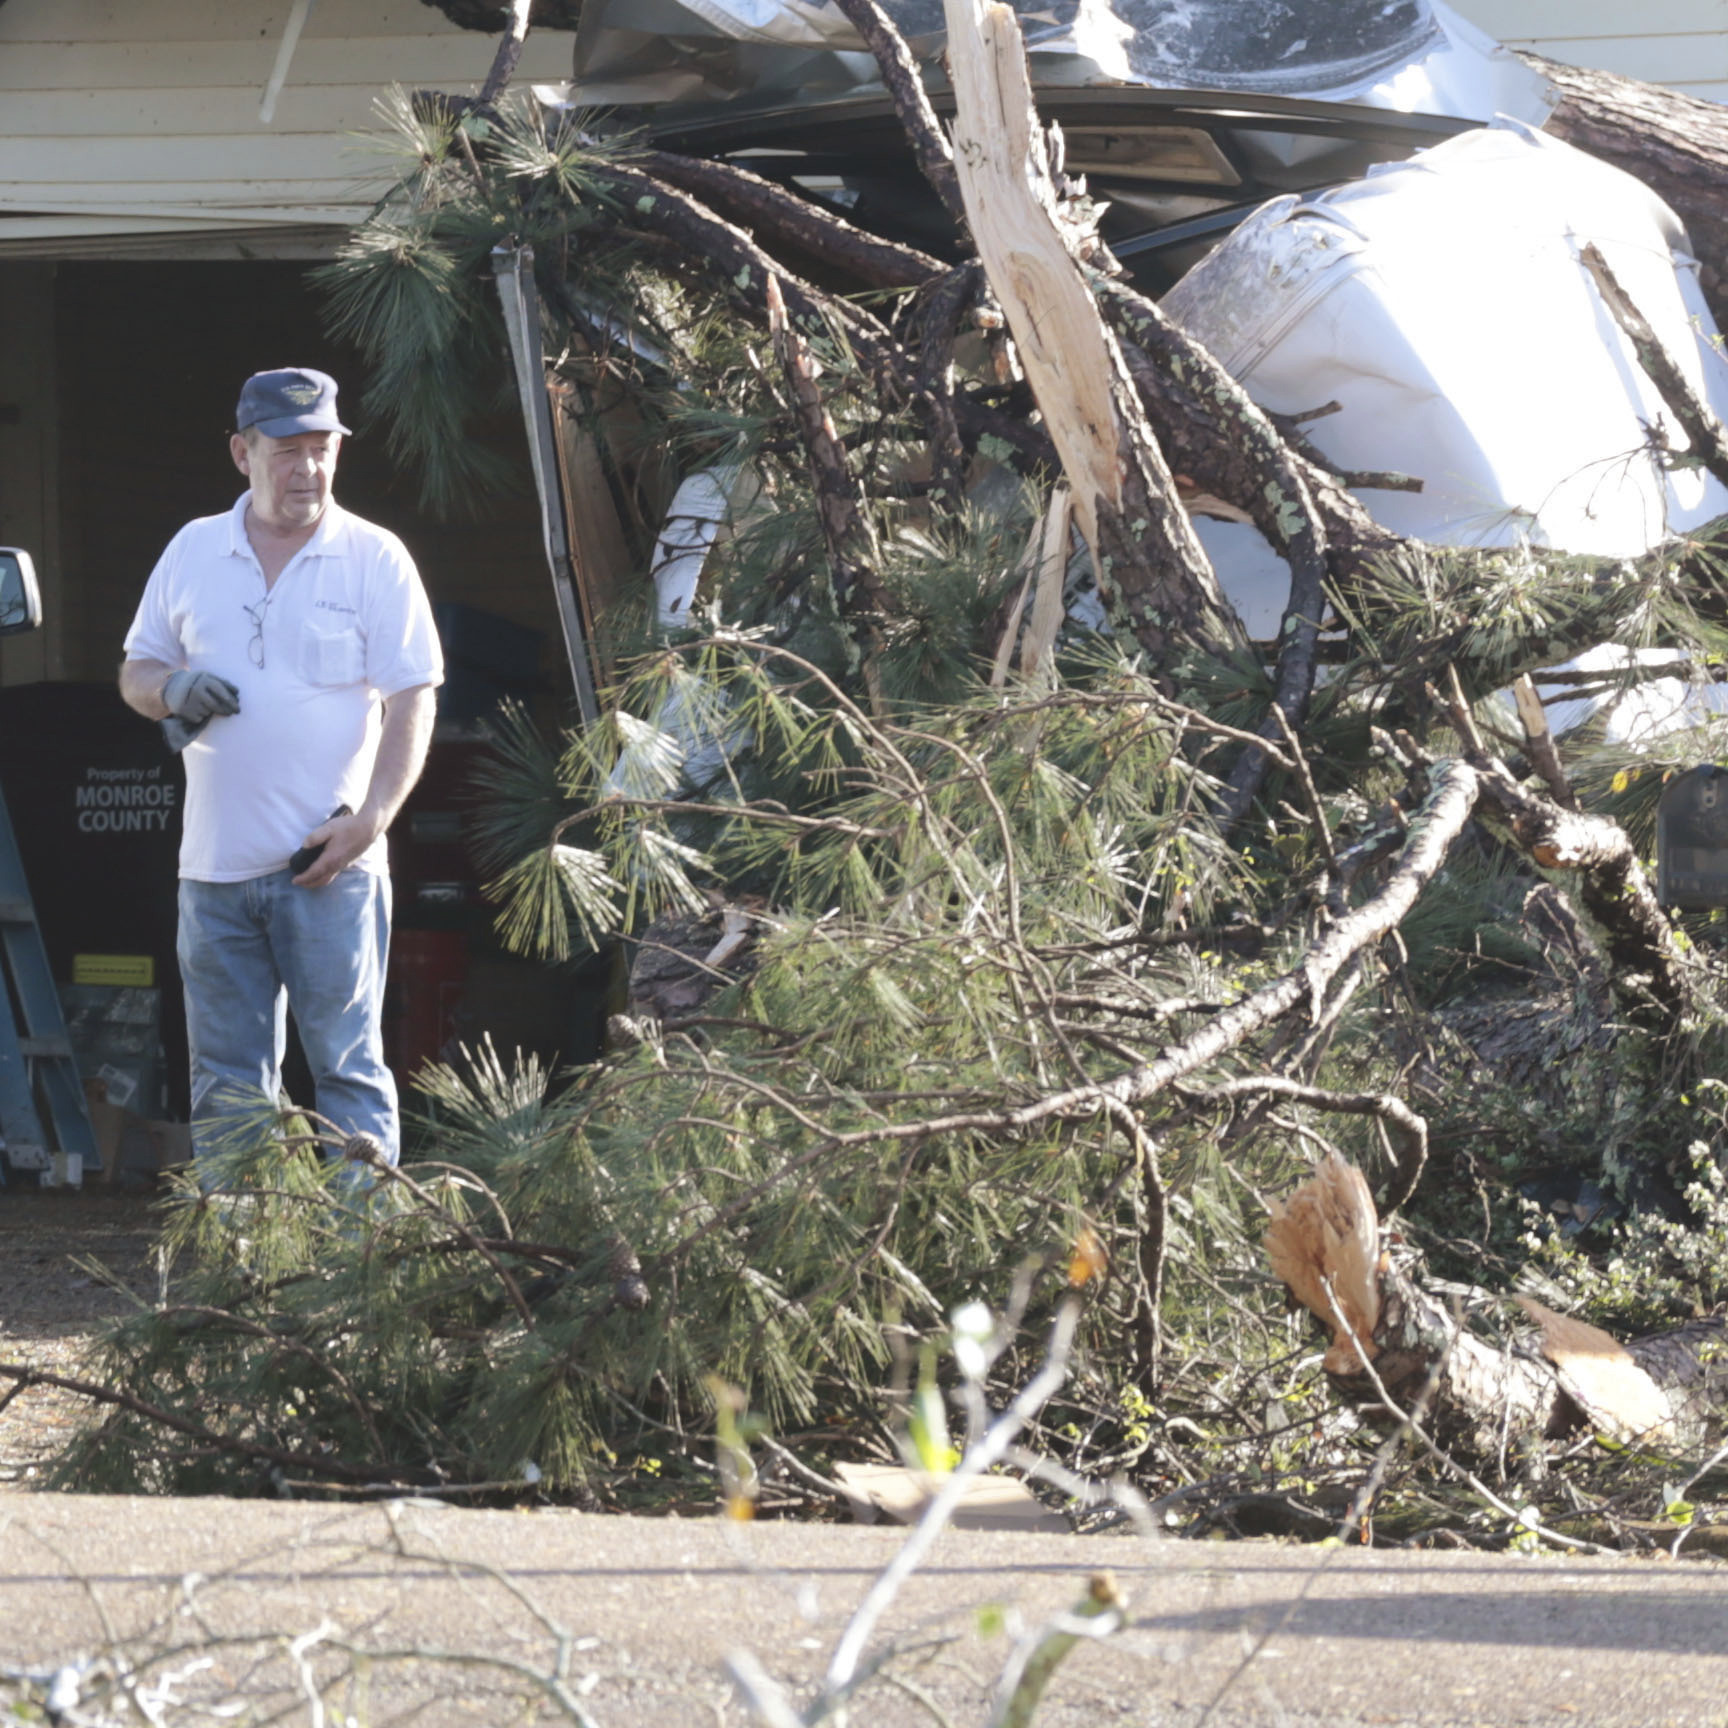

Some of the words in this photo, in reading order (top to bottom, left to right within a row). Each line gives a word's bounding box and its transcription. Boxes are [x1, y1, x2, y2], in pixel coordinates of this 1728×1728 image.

[87, 766, 144, 782] Property
[147, 765, 161, 780] of
[76, 784, 175, 807] MONROE
[79, 809, 170, 831] COUNTY
